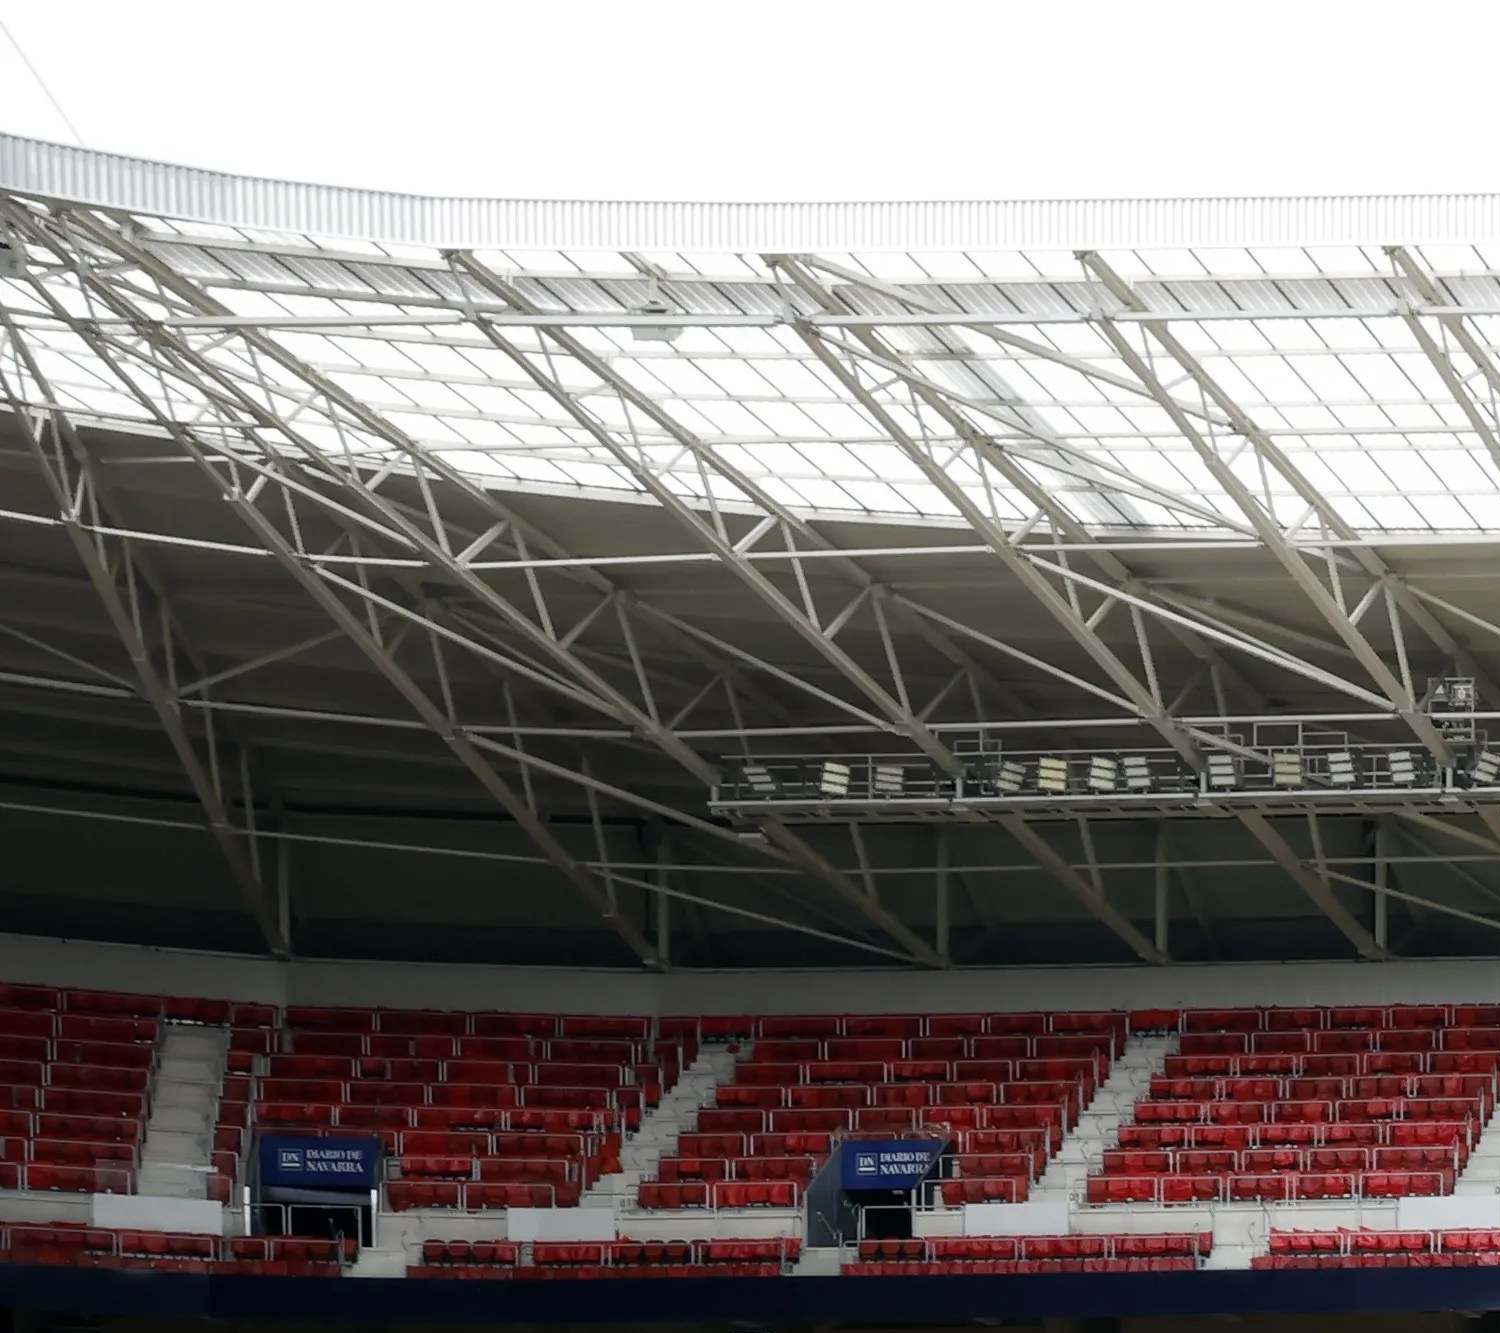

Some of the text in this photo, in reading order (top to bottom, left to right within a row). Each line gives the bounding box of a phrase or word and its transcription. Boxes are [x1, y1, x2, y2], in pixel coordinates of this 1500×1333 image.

[306, 1150, 363, 1160] DIARIO DE
[880, 1152, 930, 1162] DIARIO DE
[306, 1161, 364, 1173] NAVARRA
